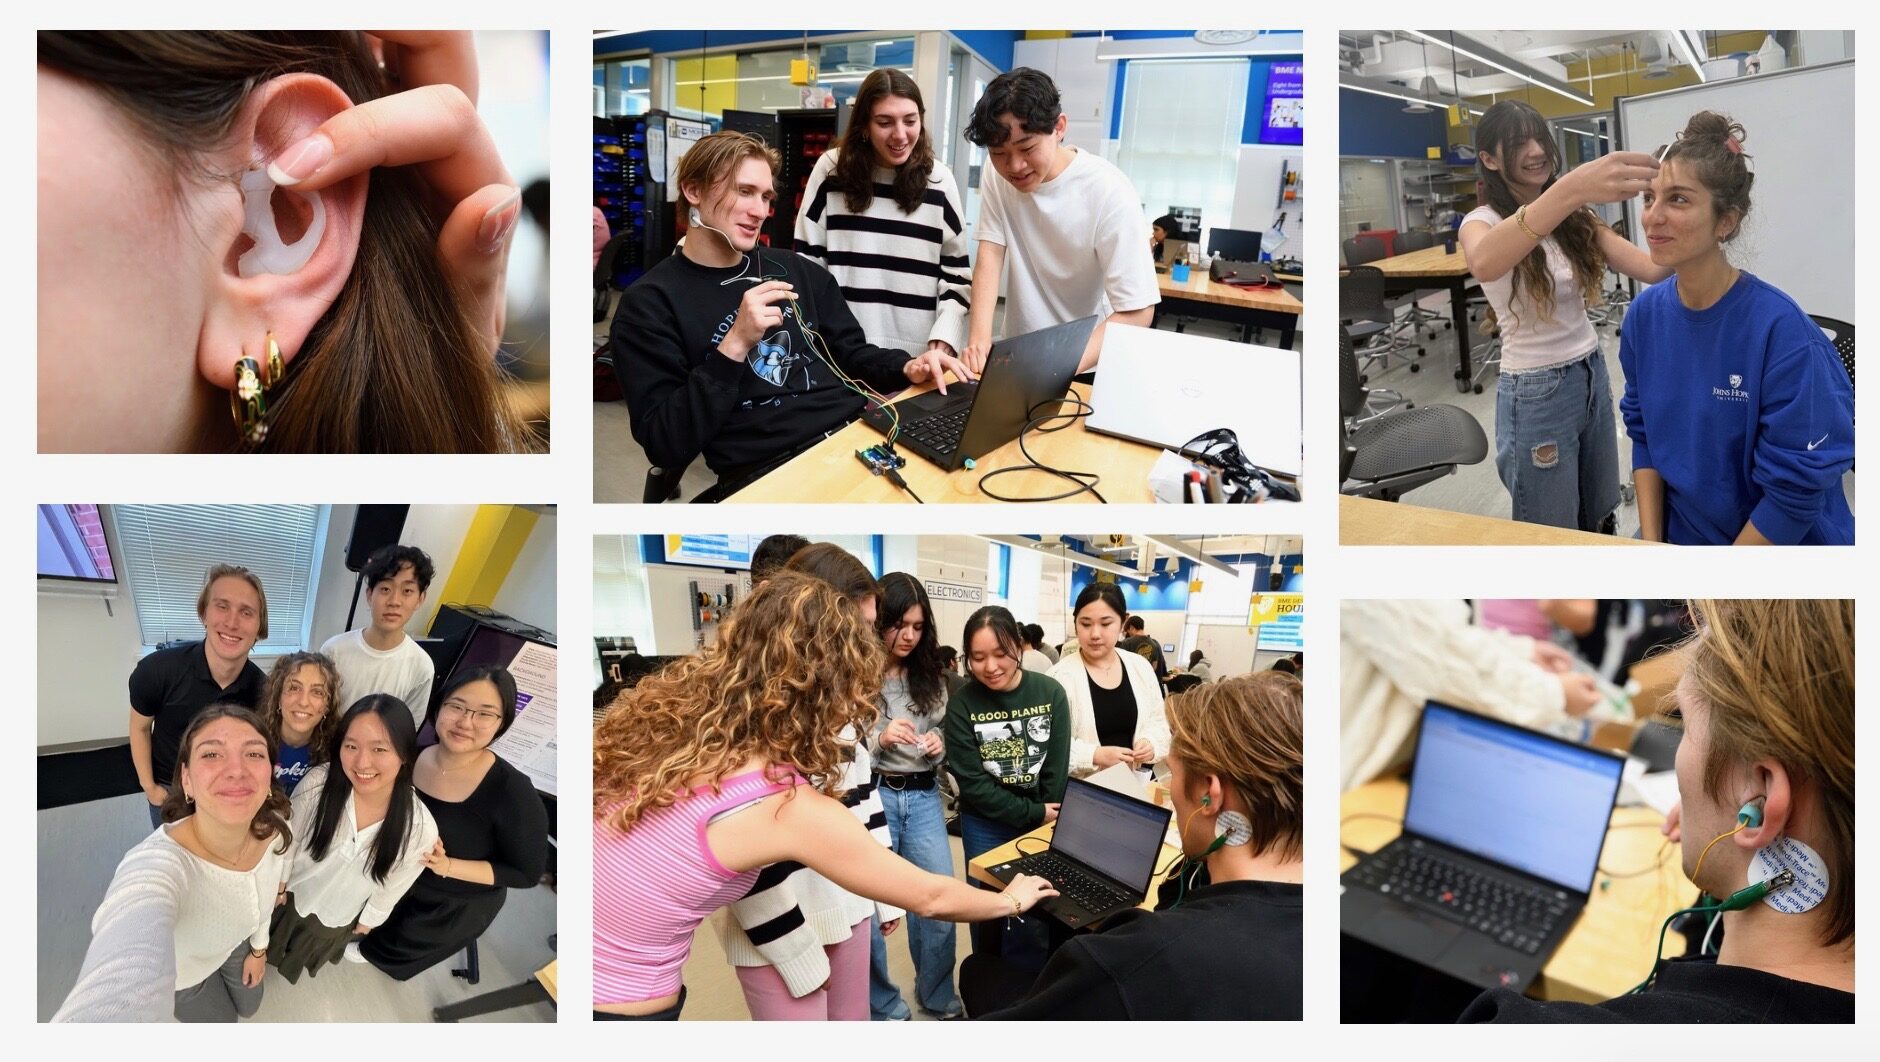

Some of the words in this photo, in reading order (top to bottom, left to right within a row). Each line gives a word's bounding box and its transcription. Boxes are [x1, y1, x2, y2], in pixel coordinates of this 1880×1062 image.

[1275, 66, 1294, 74] BME
[711, 308, 740, 344] HOP
[927, 585, 981, 600] ELECTRONICS
[977, 710, 1009, 722] GOOD
[1011, 703, 1052, 718] PLANET
[1018, 775, 1032, 783] TO
